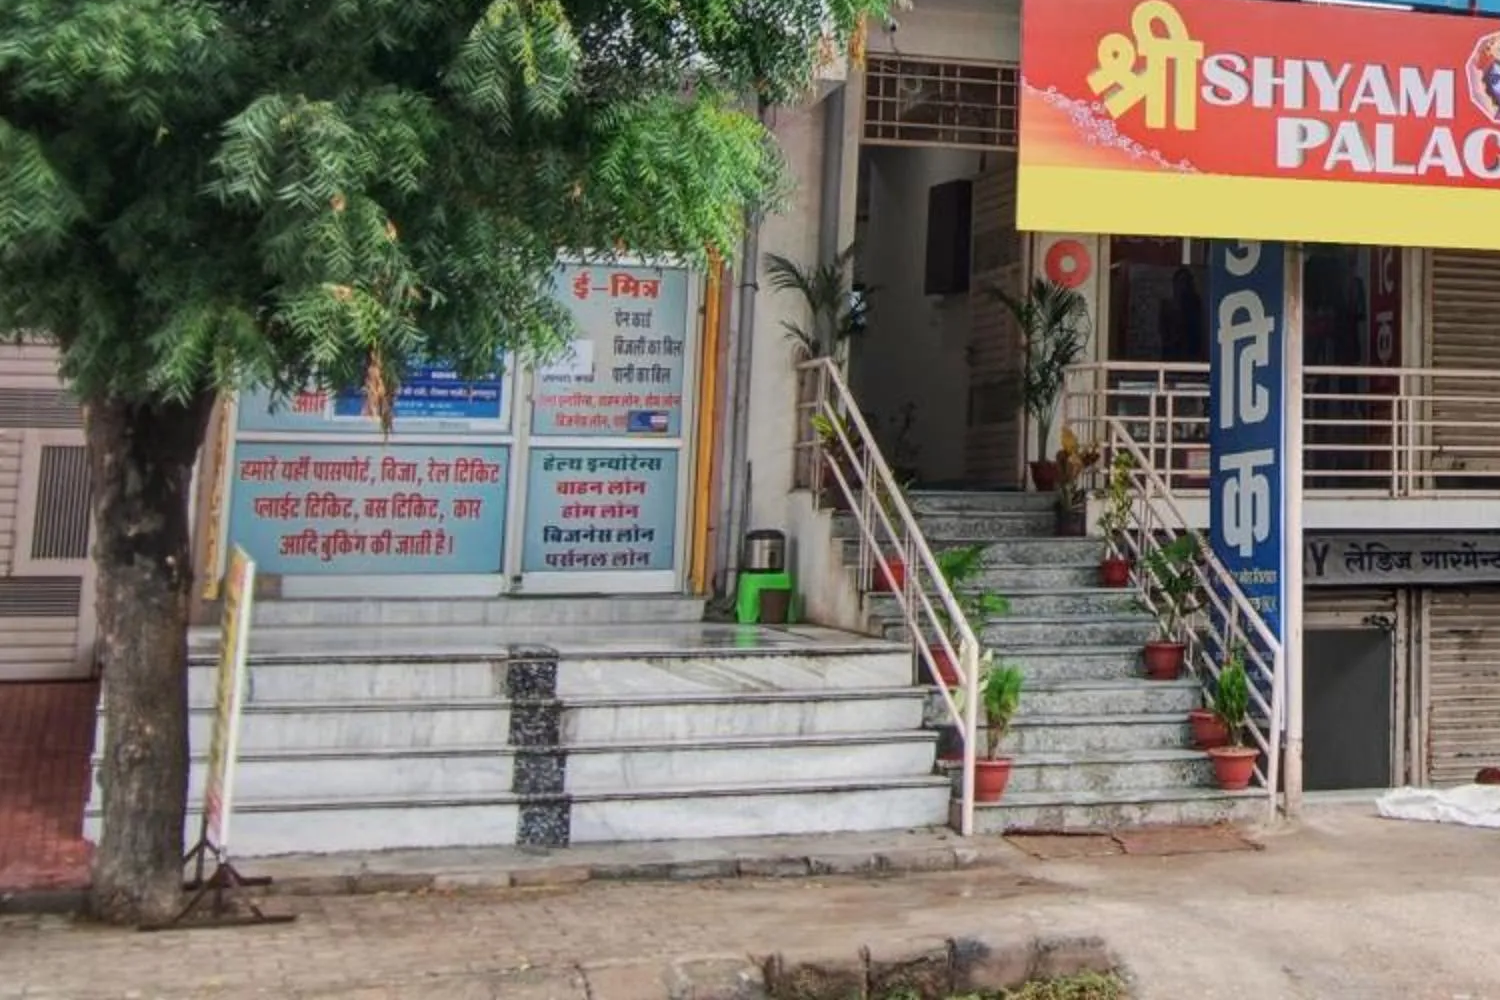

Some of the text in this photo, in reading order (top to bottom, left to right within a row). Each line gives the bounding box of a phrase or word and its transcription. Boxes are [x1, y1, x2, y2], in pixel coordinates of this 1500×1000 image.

[1086, 0, 1457, 131] श्री SHYAM
[239, 456, 277, 481] हमारे
[428, 456, 450, 482] रेल
[454, 457, 500, 483] टिकिट
[607, 476, 646, 495] लोन
[364, 497, 389, 519] बस
[453, 498, 483, 519] कार
[560, 500, 640, 518] होम लोन
[279, 528, 319, 556] आदि
[320, 529, 368, 561] बुकिंग
[370, 528, 393, 555] की
[395, 528, 432, 555] जाती
[543, 524, 655, 543] बिजनेस लोन
[545, 547, 651, 567] पर्सनल लोन
[1344, 542, 1413, 574] लेडिज
